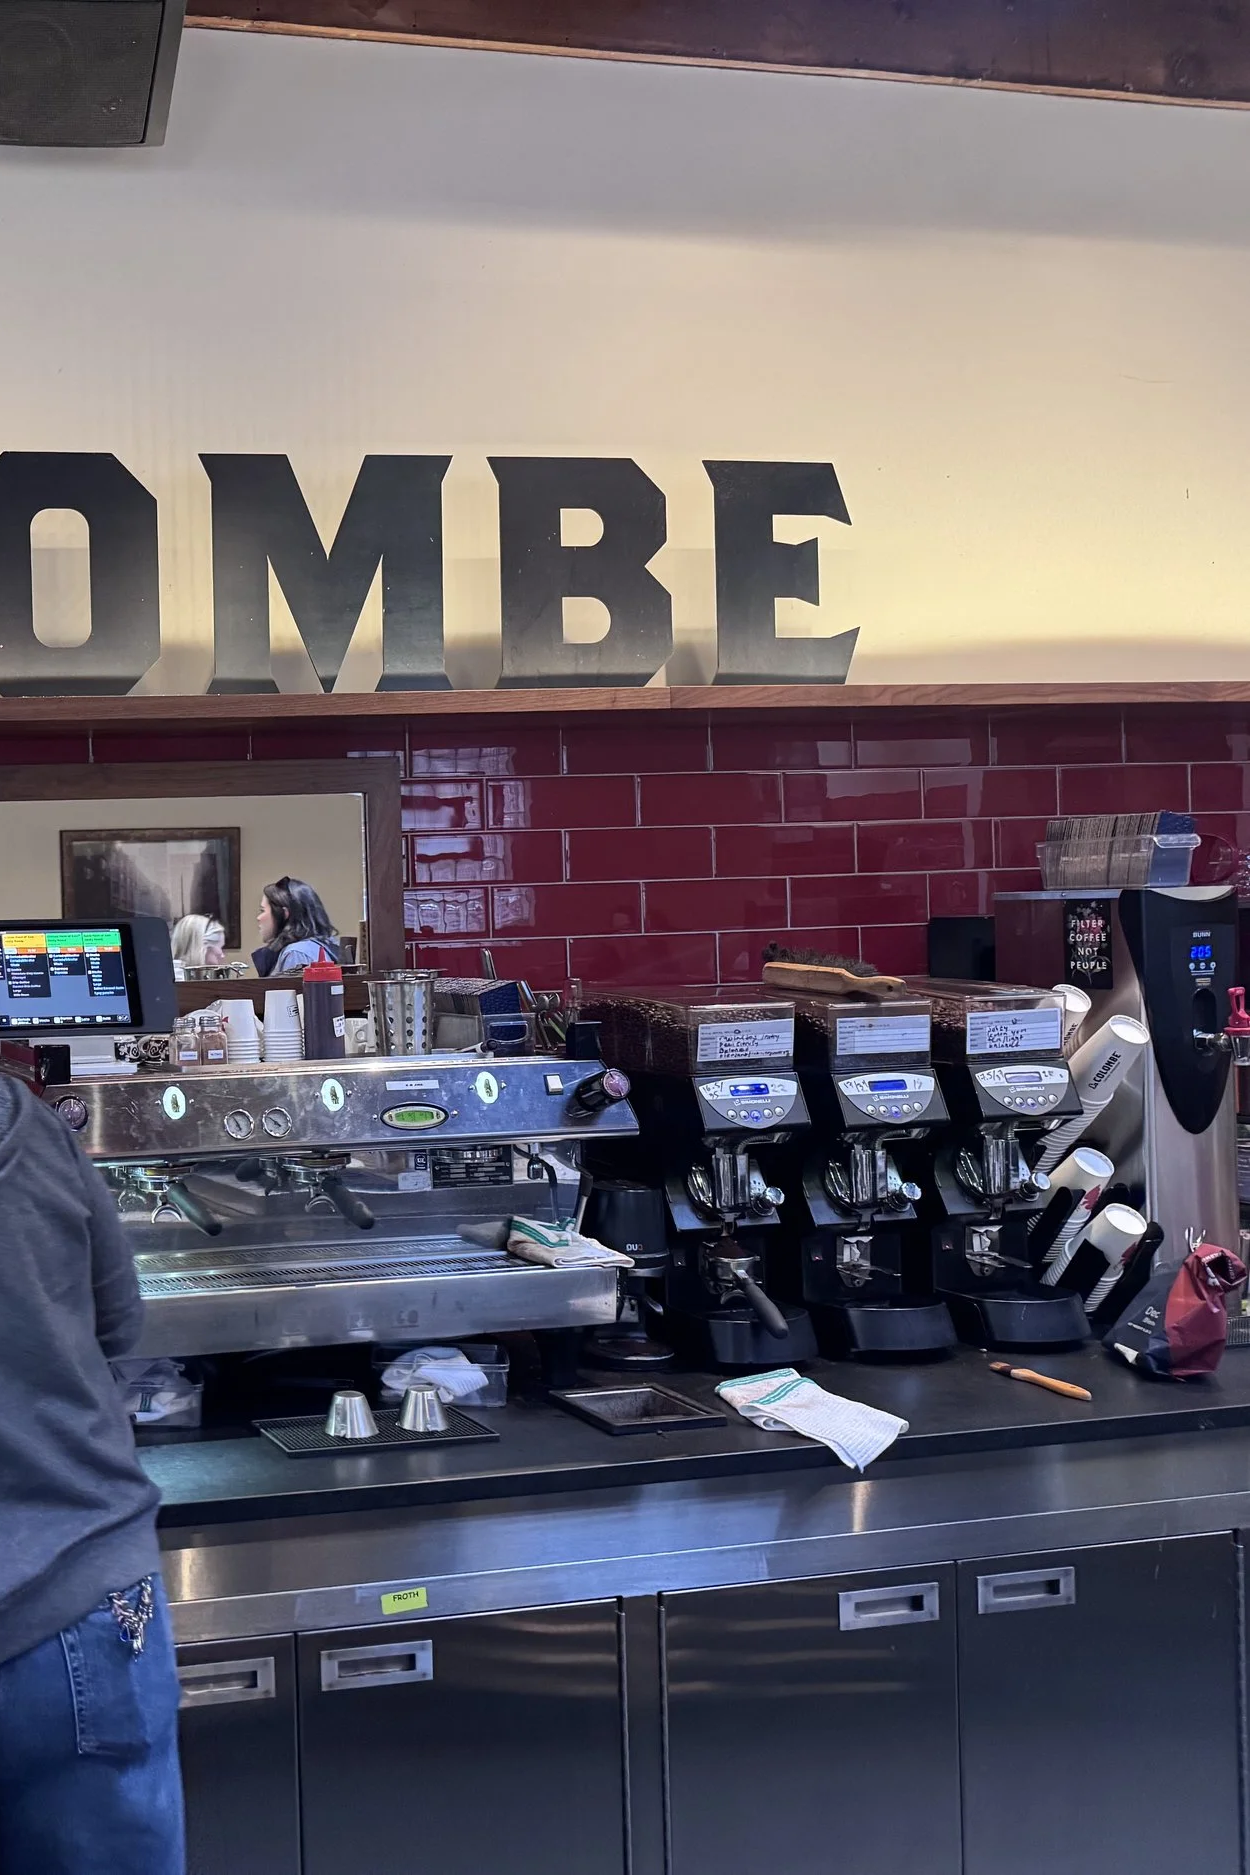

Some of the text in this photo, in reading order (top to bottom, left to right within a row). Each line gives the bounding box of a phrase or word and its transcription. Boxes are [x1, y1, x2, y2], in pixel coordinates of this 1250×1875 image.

[1070, 919, 1104, 929] FILTER
[1069, 932, 1107, 942] COFFEE
[1077, 947, 1099, 956] NOT
[1190, 945, 1212, 959] 205
[1070, 960, 1107, 970] PEOPLE
[1093, 1050, 1122, 1085] COLOMBE
[392, 1591, 419, 1602] FROTH
